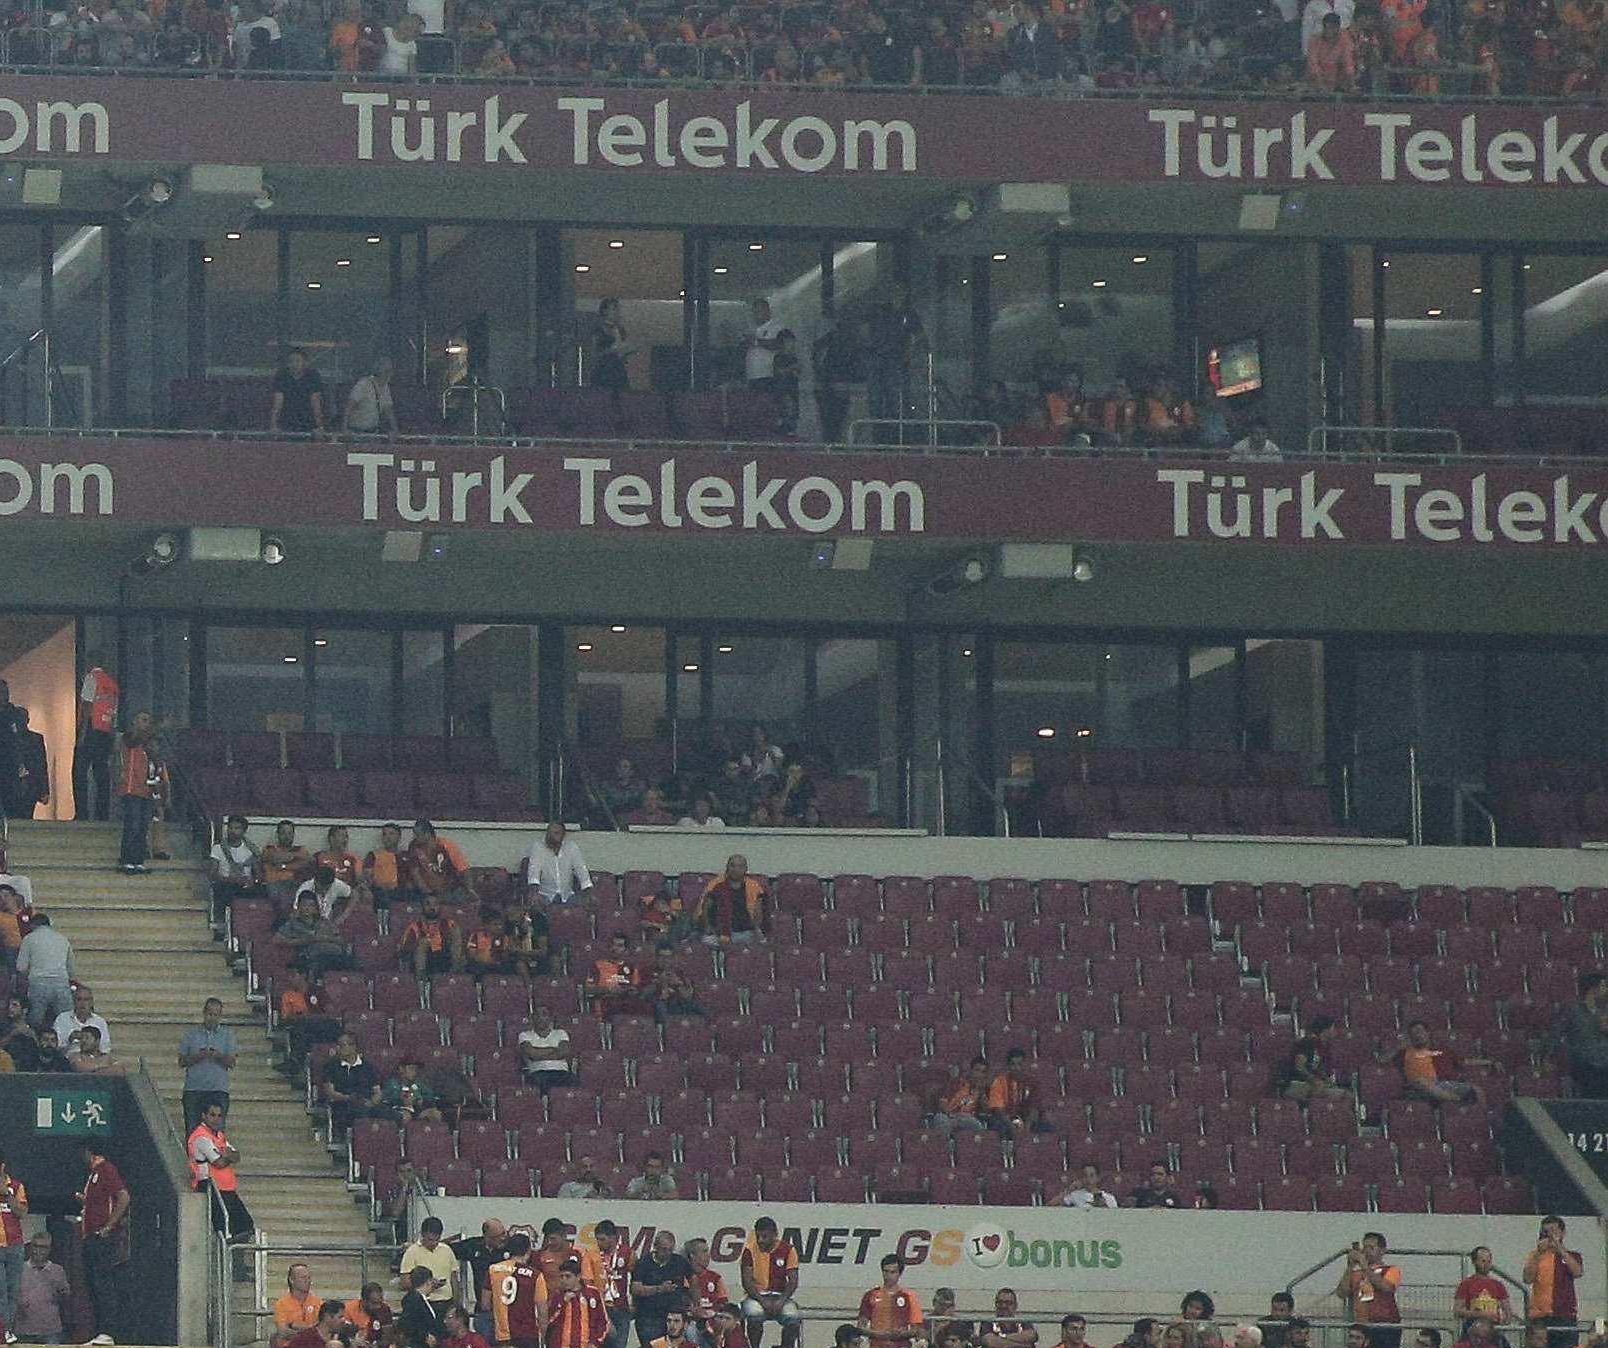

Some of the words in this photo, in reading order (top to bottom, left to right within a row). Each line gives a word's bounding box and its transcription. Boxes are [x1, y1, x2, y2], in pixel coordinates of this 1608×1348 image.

[342, 93, 528, 163] Türk
[558, 98, 916, 172] Telekom
[1149, 110, 1335, 179] Türk
[347, 453, 534, 523] Türk
[564, 458, 923, 532] Telekom
[1158, 470, 1344, 538] Türk
[1374, 473, 1608, 542] Telek
[1593, 1134, 1608, 1152] 2
[710, 1226, 885, 1265] GNET
[1006, 1232, 1122, 1269] bonus
[501, 1276, 518, 1305] 9
